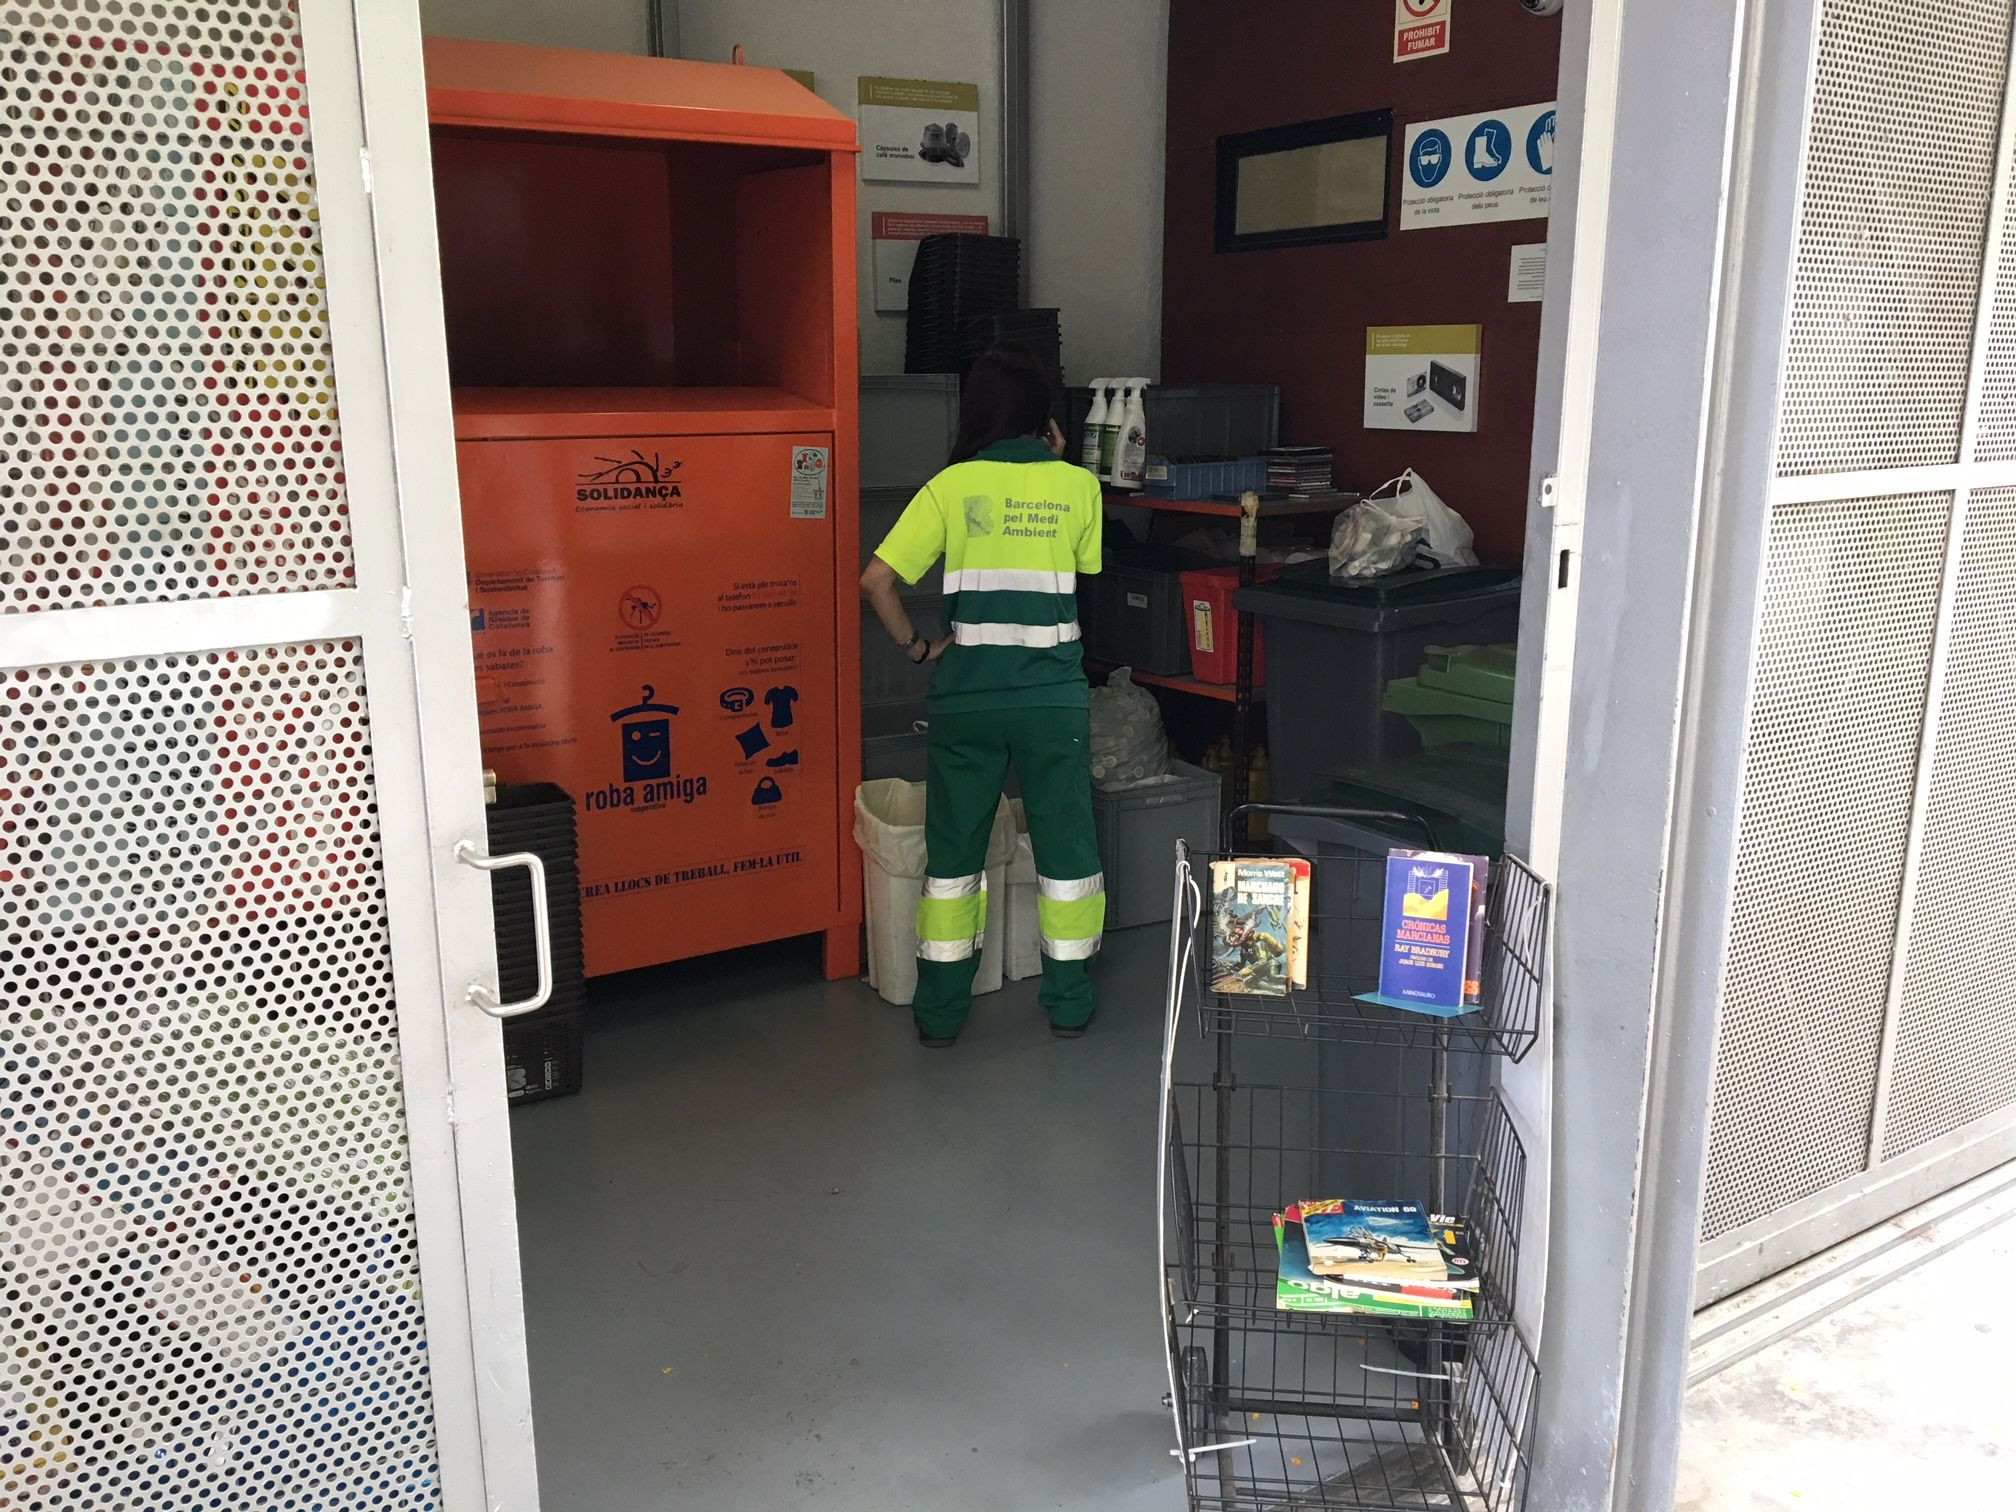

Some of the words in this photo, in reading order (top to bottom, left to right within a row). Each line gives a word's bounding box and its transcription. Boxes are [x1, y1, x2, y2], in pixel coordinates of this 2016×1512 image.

[1403, 26, 1441, 42] PROHIBIT
[1407, 37, 1435, 51] FUMAR
[1458, 192, 1484, 200] Protecció
[576, 485, 681, 502] SOLIDANÇA
[575, 504, 616, 513] Economia
[618, 503, 641, 511] social
[1004, 498, 1070, 513] Barcelona
[1003, 513, 1023, 524] pel
[1027, 514, 1059, 525] Medi
[1002, 525, 1058, 538] Ambient
[509, 648, 521, 656] de
[522, 647, 531, 655] la
[585, 783, 635, 811] roba
[643, 774, 708, 804] amiga
[614, 875, 652, 893] LLOCS
[654, 871, 671, 886] DE
[733, 855, 774, 873] FEM-LA
[1237, 868, 1262, 877] Morris
[1263, 869, 1285, 878] West
[1237, 892, 1248, 904] DE
[1401, 919, 1447, 934] CRÓNICAS
[1396, 929, 1451, 945] MARCIANAS
[1394, 943, 1410, 953] RAY
[1410, 945, 1450, 959] BRADBURY
[1402, 989, 1436, 999] MINOTAURO
[1354, 1205, 1400, 1213] AVIATION
[1430, 1213, 1456, 1224] Vie
